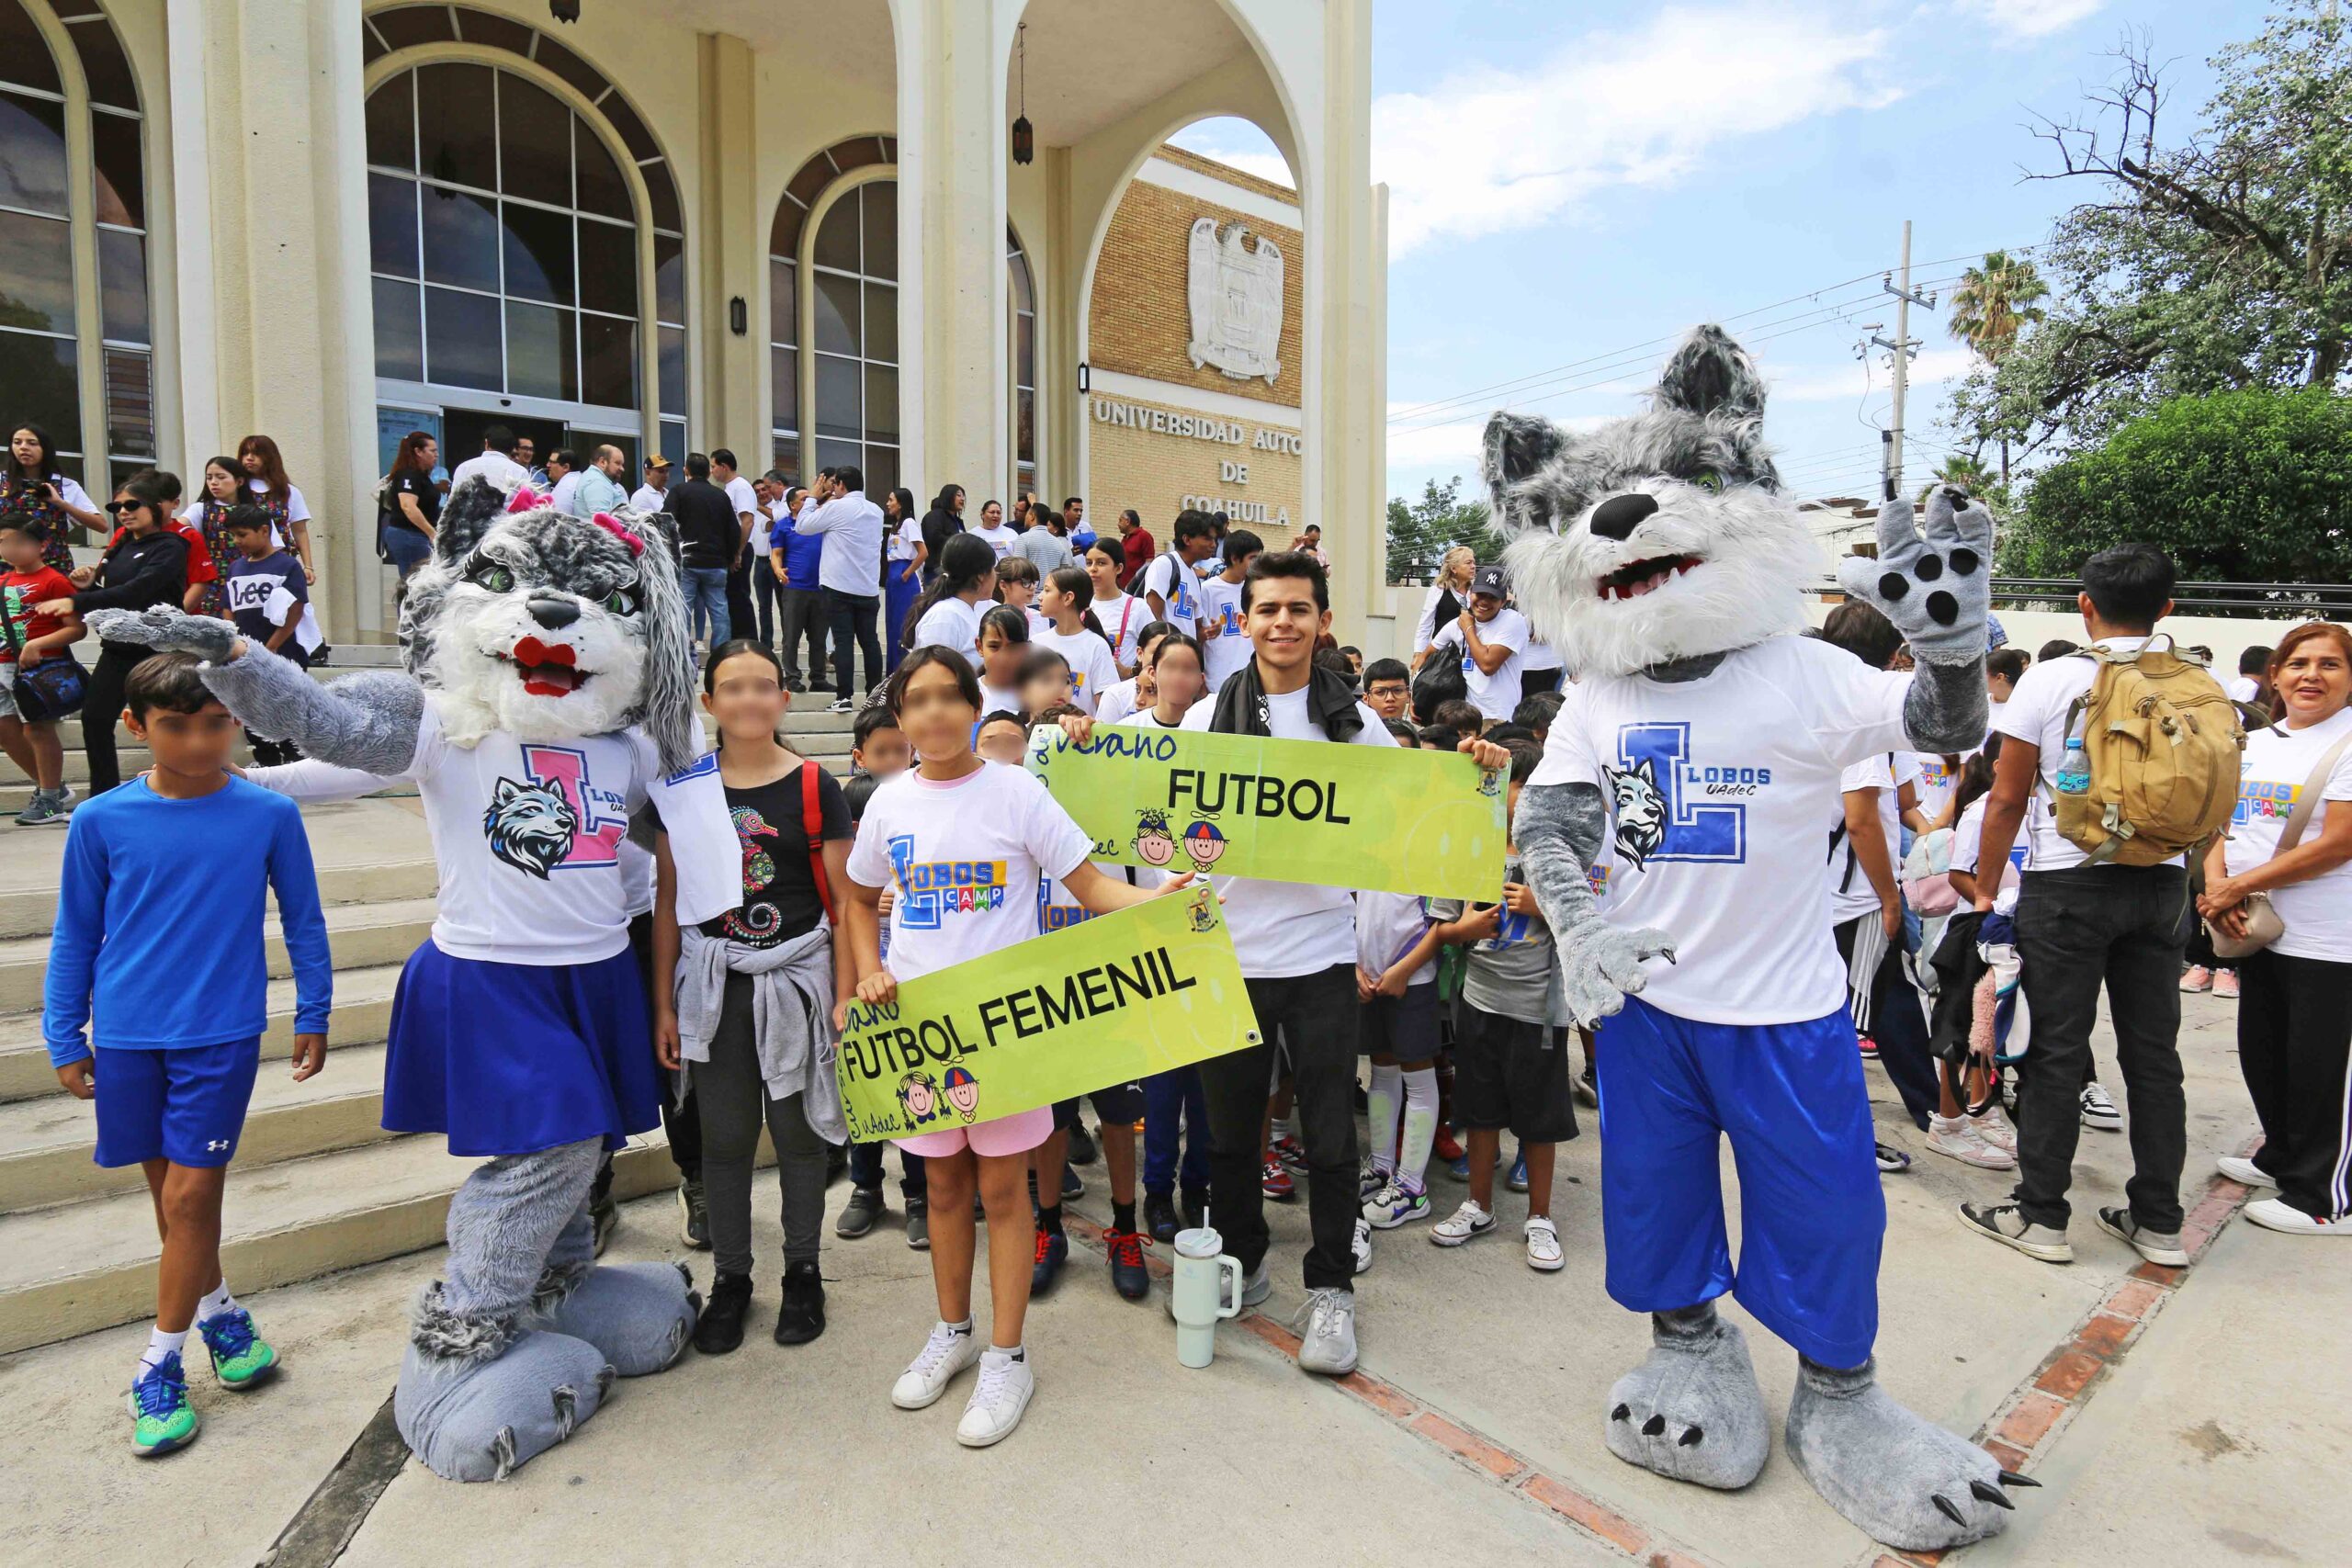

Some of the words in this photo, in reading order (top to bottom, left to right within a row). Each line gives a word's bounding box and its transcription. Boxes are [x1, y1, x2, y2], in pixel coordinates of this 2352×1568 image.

[1093, 399, 1245, 446] UNIVERSIDAD
[1219, 459, 1250, 485] DE
[1181, 493, 1291, 526] COAHUILA
[232, 580, 274, 607] Lee
[1687, 766, 1771, 785] LOBOS
[1169, 768, 1351, 825] FUTBOL
[1705, 784, 1758, 796] UAdeC
[2253, 800, 2293, 813] CAM
[945, 887, 1001, 903] CAMP
[842, 1014, 979, 1083] FUTBOL
[978, 946, 1197, 1048] FEMENIL
